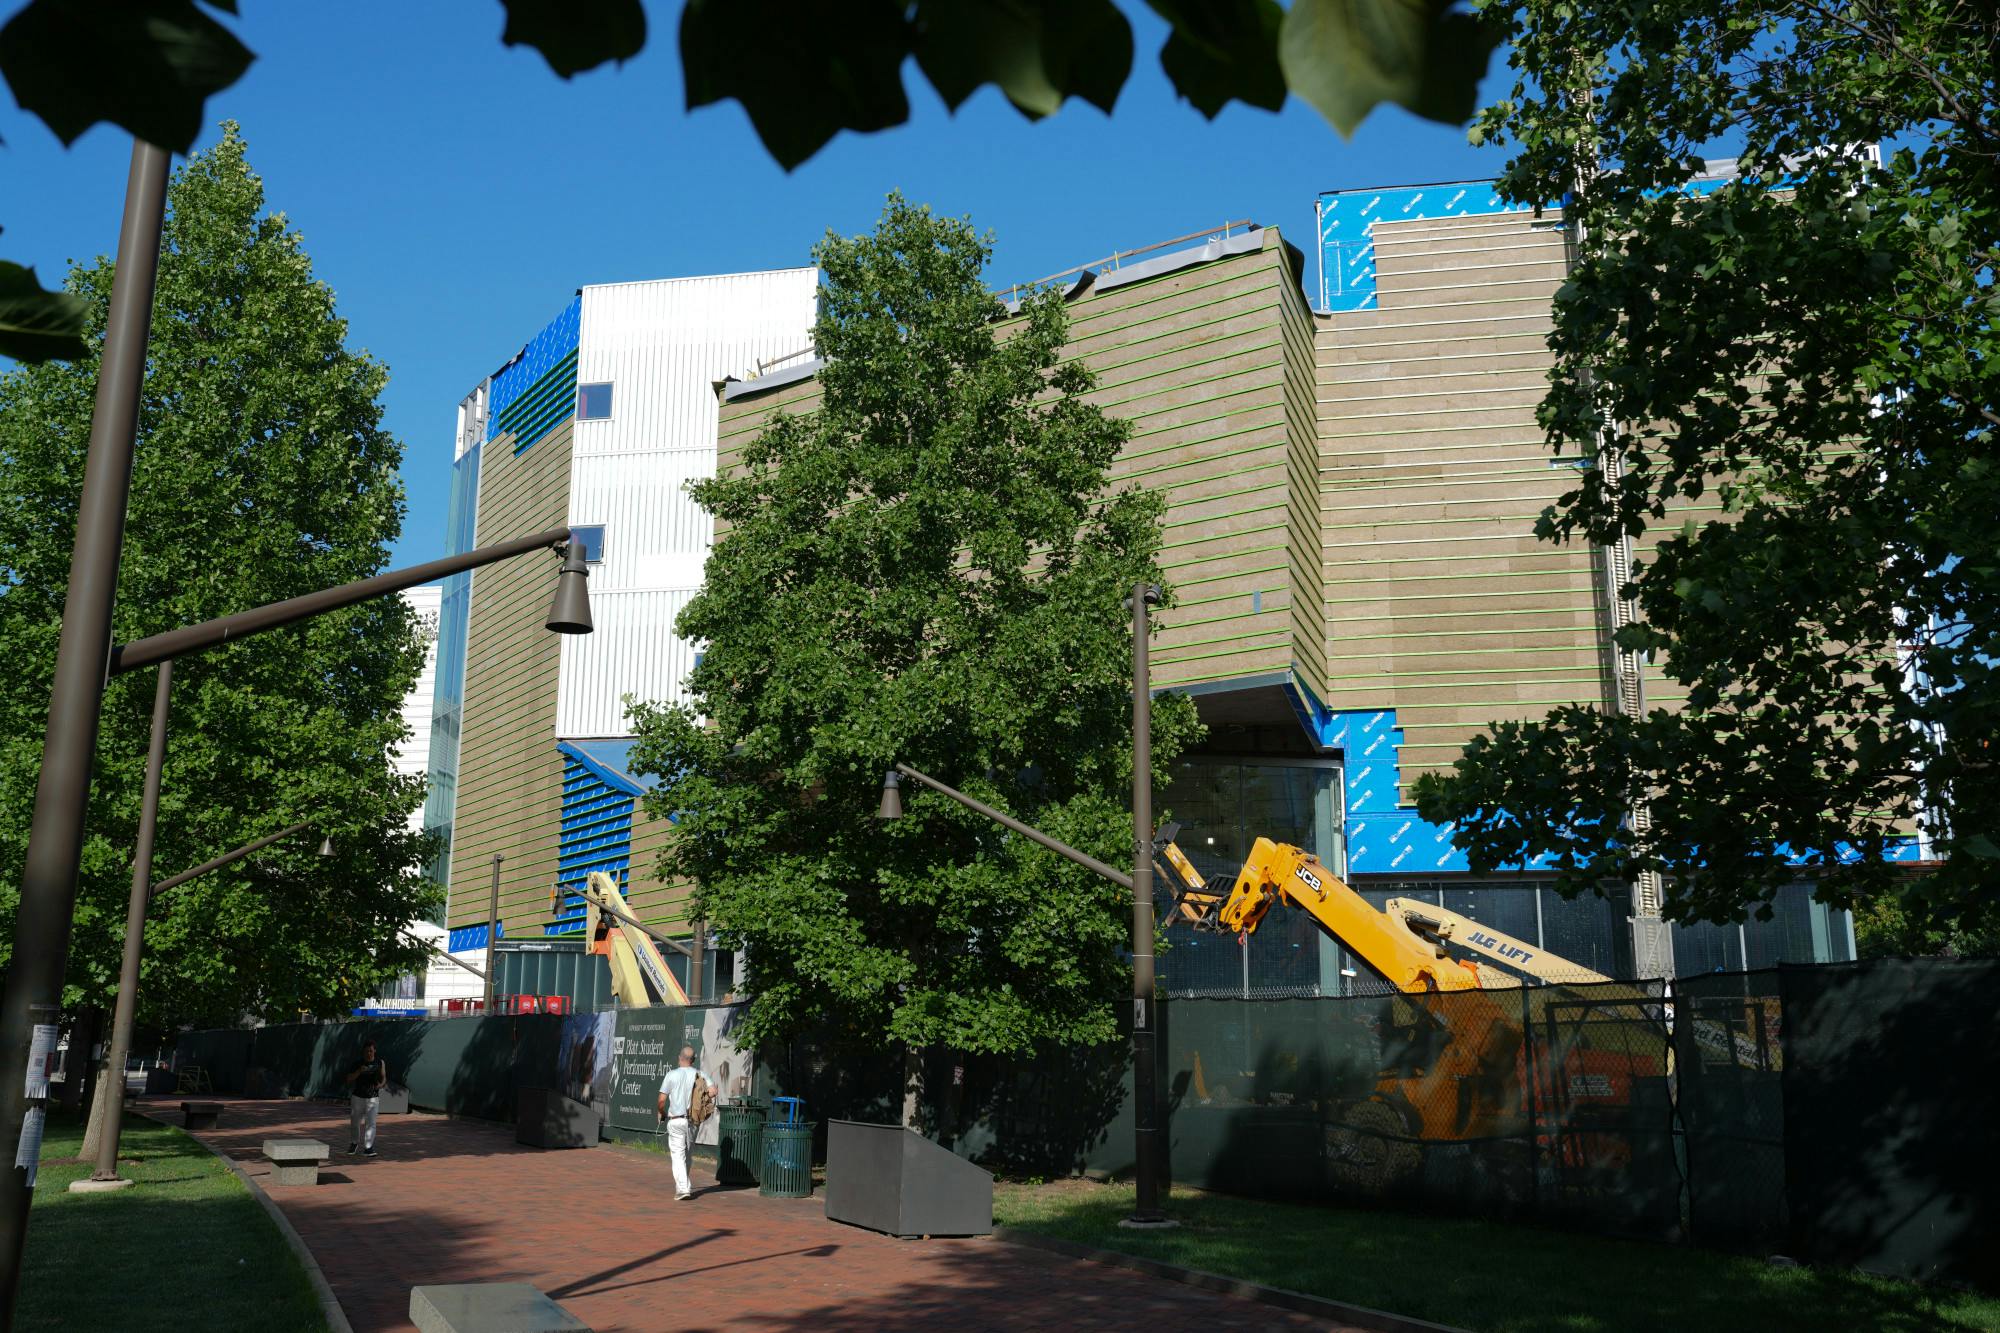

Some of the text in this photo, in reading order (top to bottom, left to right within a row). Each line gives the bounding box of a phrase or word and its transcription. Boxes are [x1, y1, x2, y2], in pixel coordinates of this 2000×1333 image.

[1295, 867, 1321, 891] JCB
[1467, 931, 1534, 964] JLG LIFT
[391, 998, 415, 1010] HOUSE
[625, 1039, 664, 1056] Platt Student
[623, 1060, 657, 1080] Performing
[621, 1079, 641, 1096] Center
